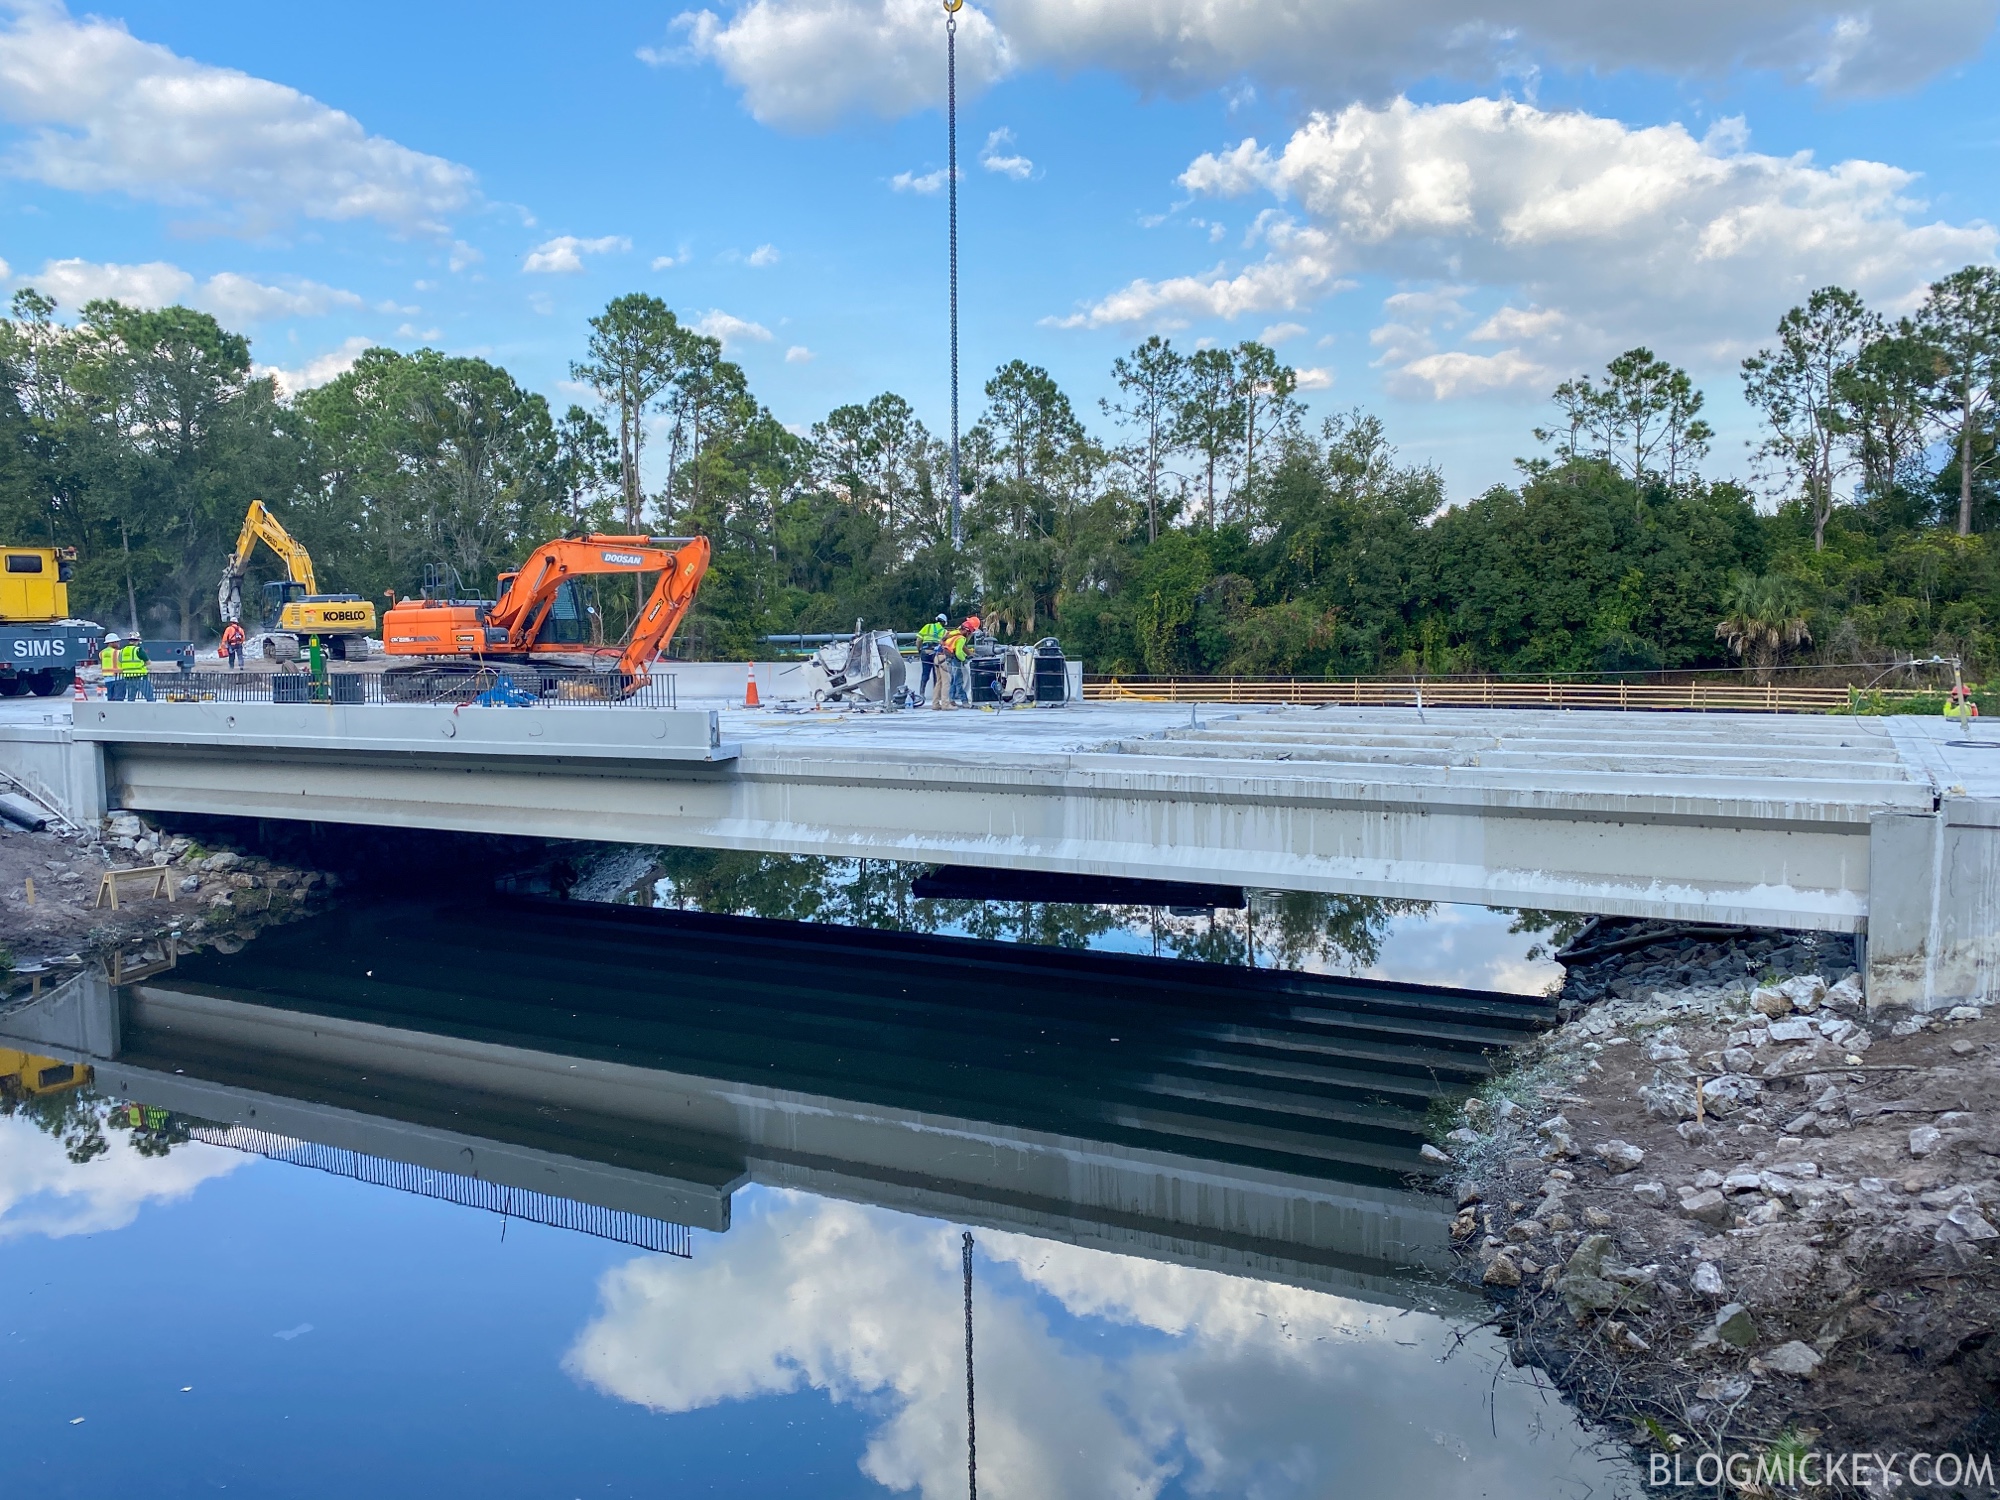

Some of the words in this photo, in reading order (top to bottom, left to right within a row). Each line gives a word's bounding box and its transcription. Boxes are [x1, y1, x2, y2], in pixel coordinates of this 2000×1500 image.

[604, 553, 642, 565] DOOSAN
[323, 610, 366, 621] KOBELCO
[13, 639, 66, 657] SIMS
